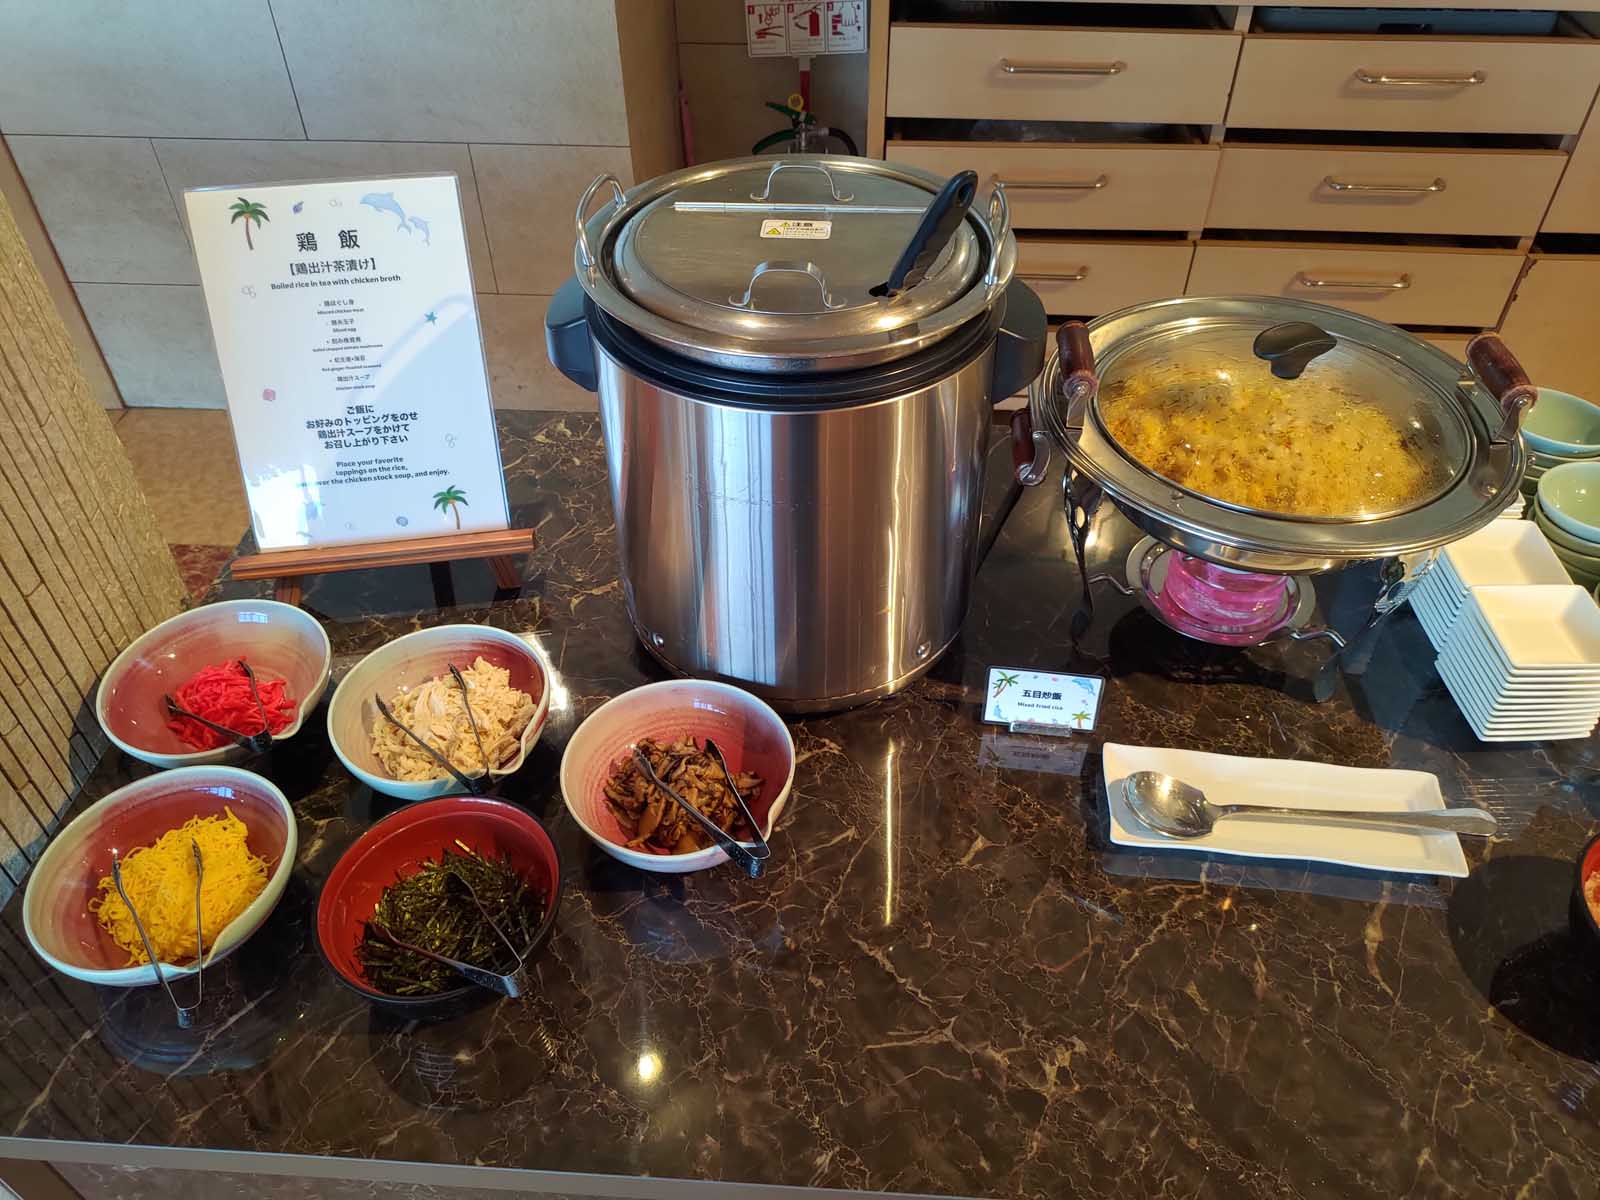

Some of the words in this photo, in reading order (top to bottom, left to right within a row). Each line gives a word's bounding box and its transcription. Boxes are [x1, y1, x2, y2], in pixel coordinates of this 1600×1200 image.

[296, 232, 318, 252] 鶏
[338, 230, 360, 249] 飯
[332, 277, 350, 286] with
[350, 276, 379, 285] chicken
[379, 275, 401, 283] broth
[374, 457, 404, 465] favorite
[335, 469, 368, 477] toppings
[378, 465, 392, 473] the
[344, 475, 373, 484] chicken
[373, 473, 393, 481] stock
[394, 472, 414, 480] soup,
[428, 468, 450, 478] enjoy.
[1022, 689, 1063, 700] 五目炒飯
